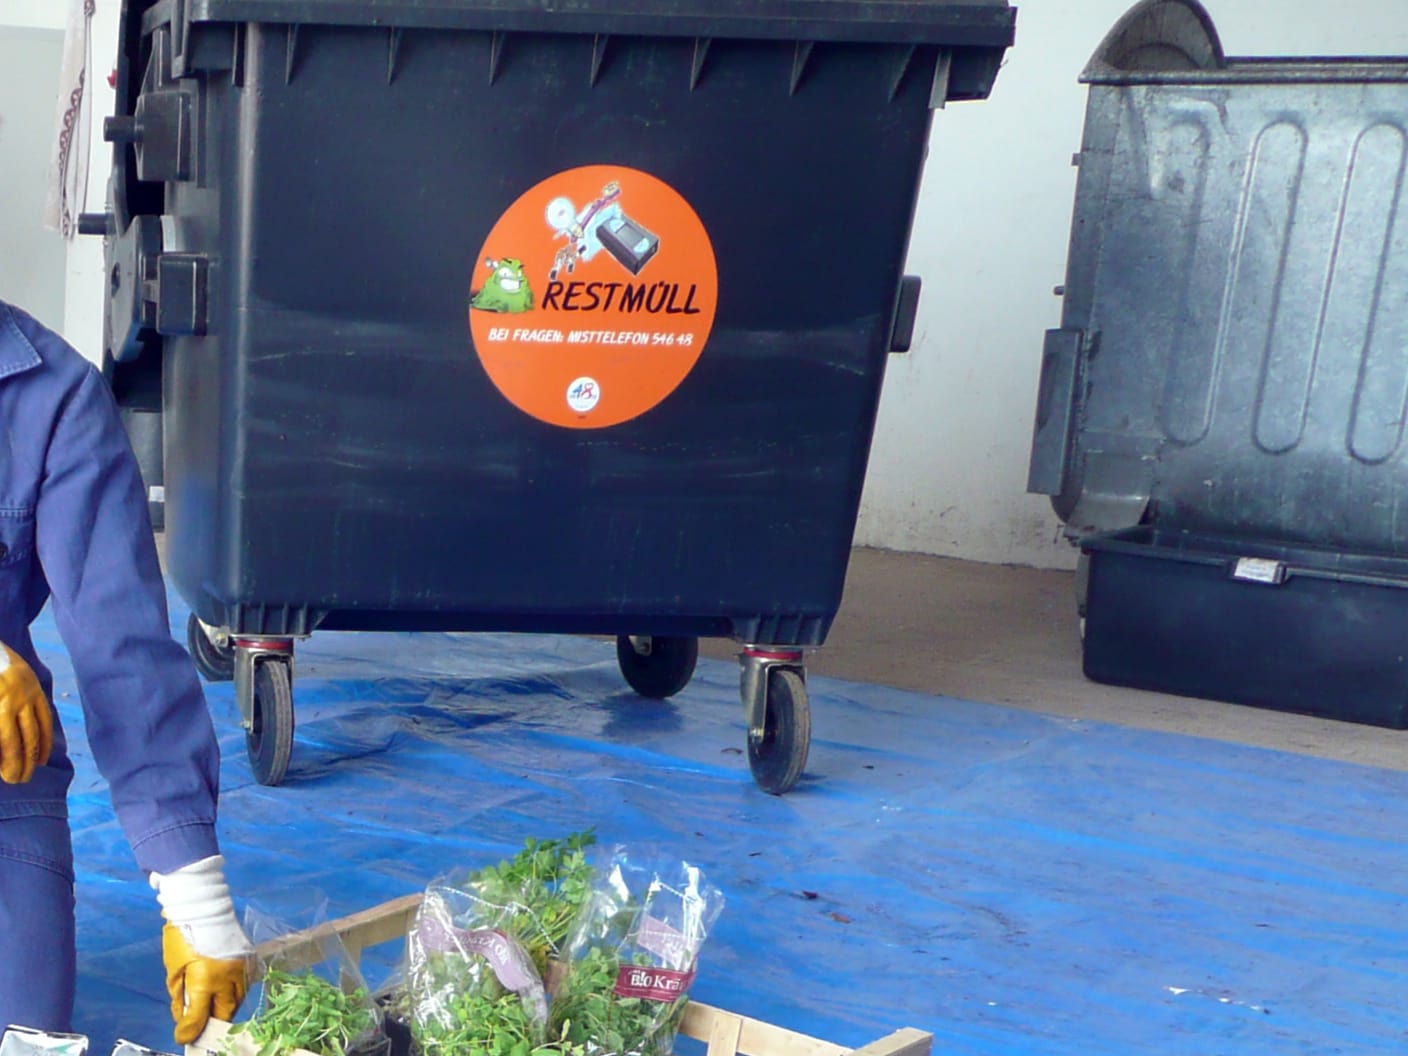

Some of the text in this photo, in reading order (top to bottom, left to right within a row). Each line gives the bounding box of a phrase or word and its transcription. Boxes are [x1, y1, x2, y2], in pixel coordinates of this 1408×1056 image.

[542, 280, 701, 314] RESTMÜLL
[488, 328, 508, 341] BEI
[513, 329, 564, 343] FRAGEN:
[568, 330, 649, 346] MISTTELEFON
